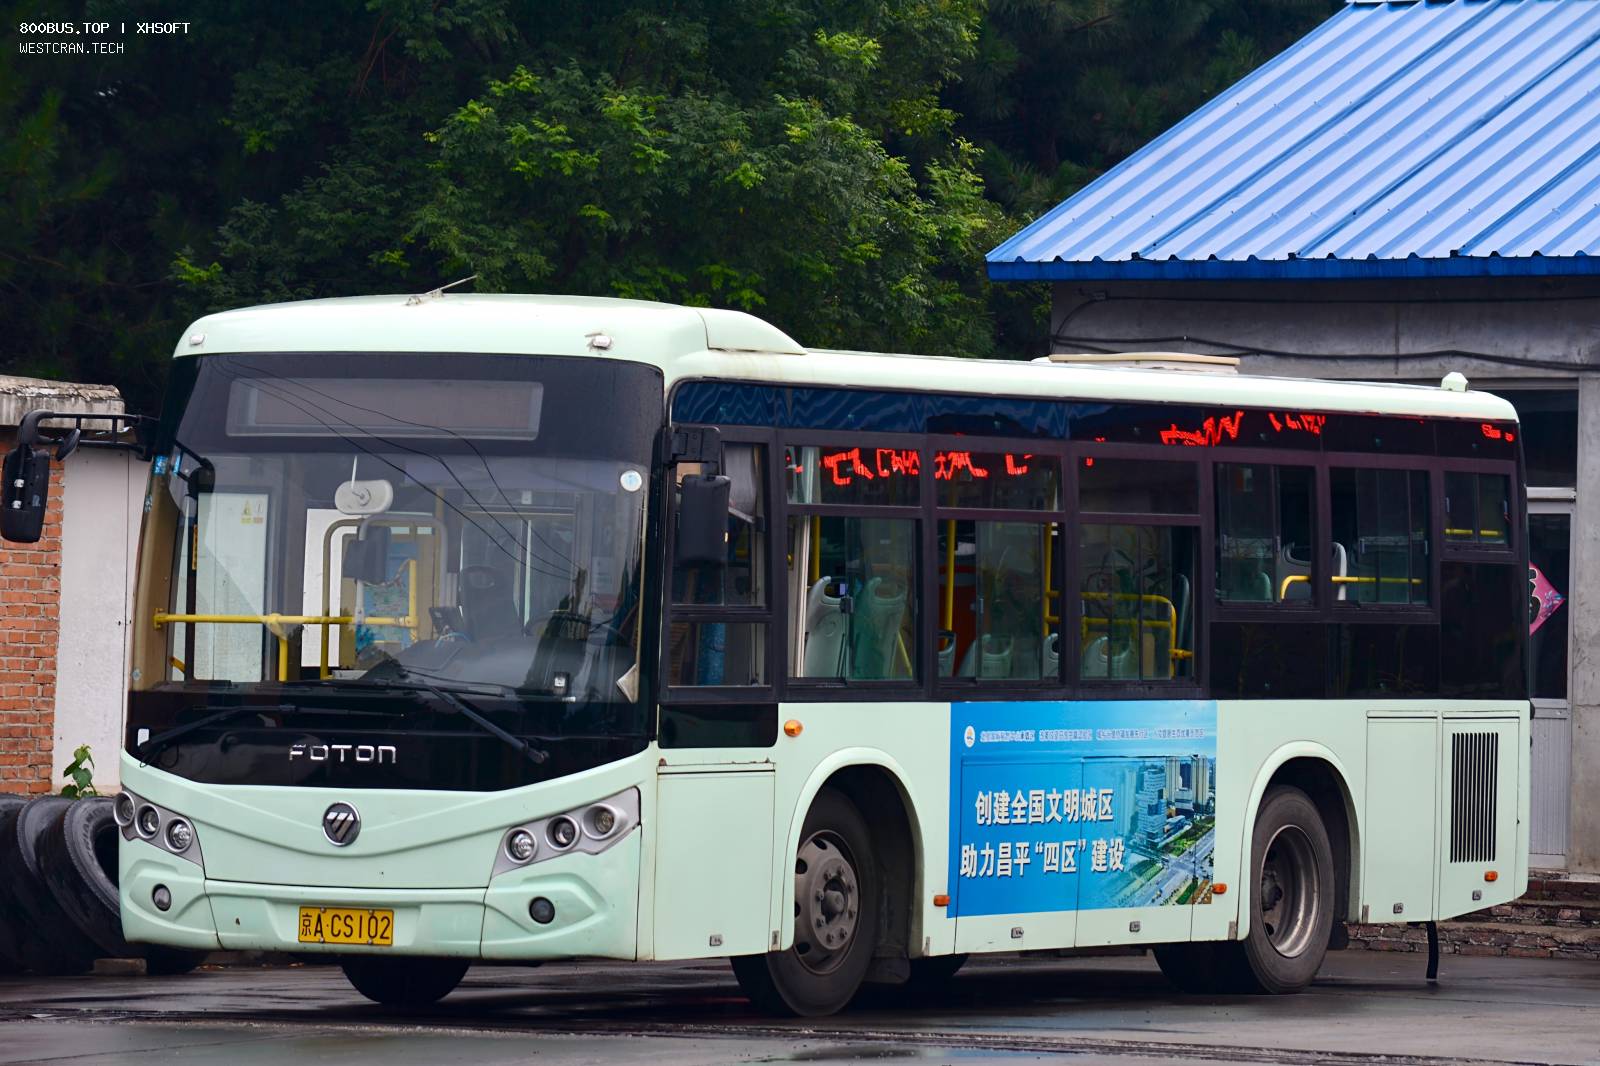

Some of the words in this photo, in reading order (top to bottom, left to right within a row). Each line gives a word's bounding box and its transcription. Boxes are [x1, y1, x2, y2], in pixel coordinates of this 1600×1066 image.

[289, 744, 397, 764] FOTON
[975, 787, 1115, 826] 创建全国文明城区
[959, 838, 1126, 879] 助力昌平“四区”建设
